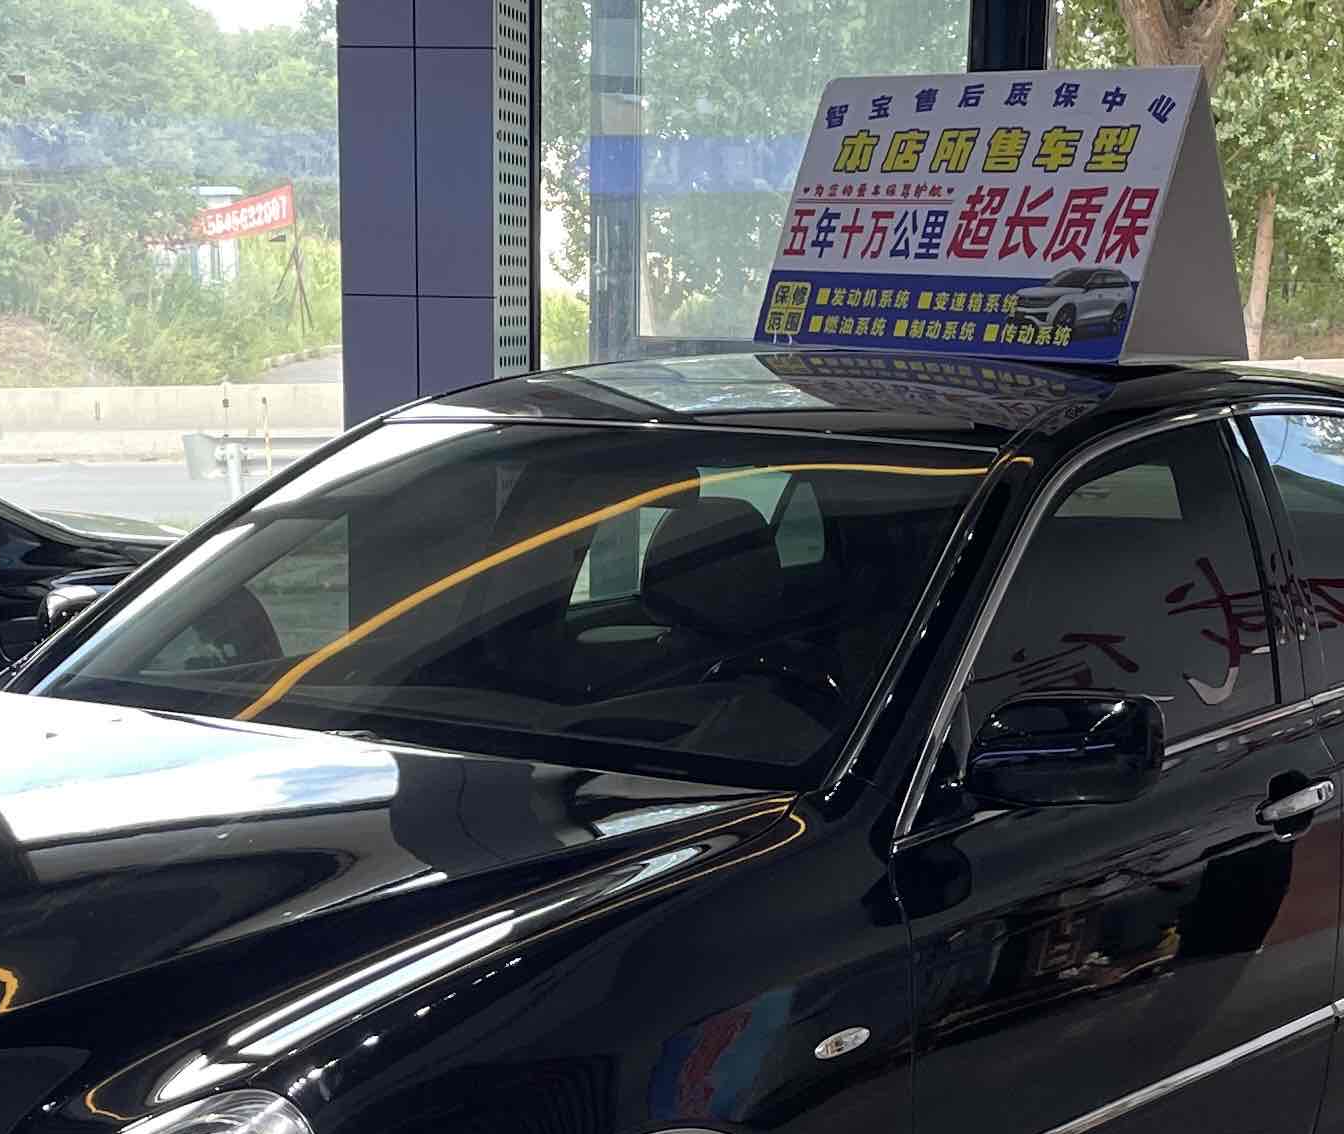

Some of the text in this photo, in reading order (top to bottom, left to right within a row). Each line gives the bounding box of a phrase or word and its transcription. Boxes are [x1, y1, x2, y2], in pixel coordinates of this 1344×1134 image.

[825, 82, 1176, 129] 智宝售后质保中心
[833, 125, 1141, 173] 本店所售车型
[784, 207, 949, 260] 五年十万公里
[947, 185, 1159, 264] 超长质保
[831, 288, 910, 310] 发动机系统
[933, 292, 1019, 316] 变速箱系统
[823, 315, 887, 337] 燃油系统
[910, 319, 975, 342] 制动系统
[1000, 323, 1072, 347] 传动系统
